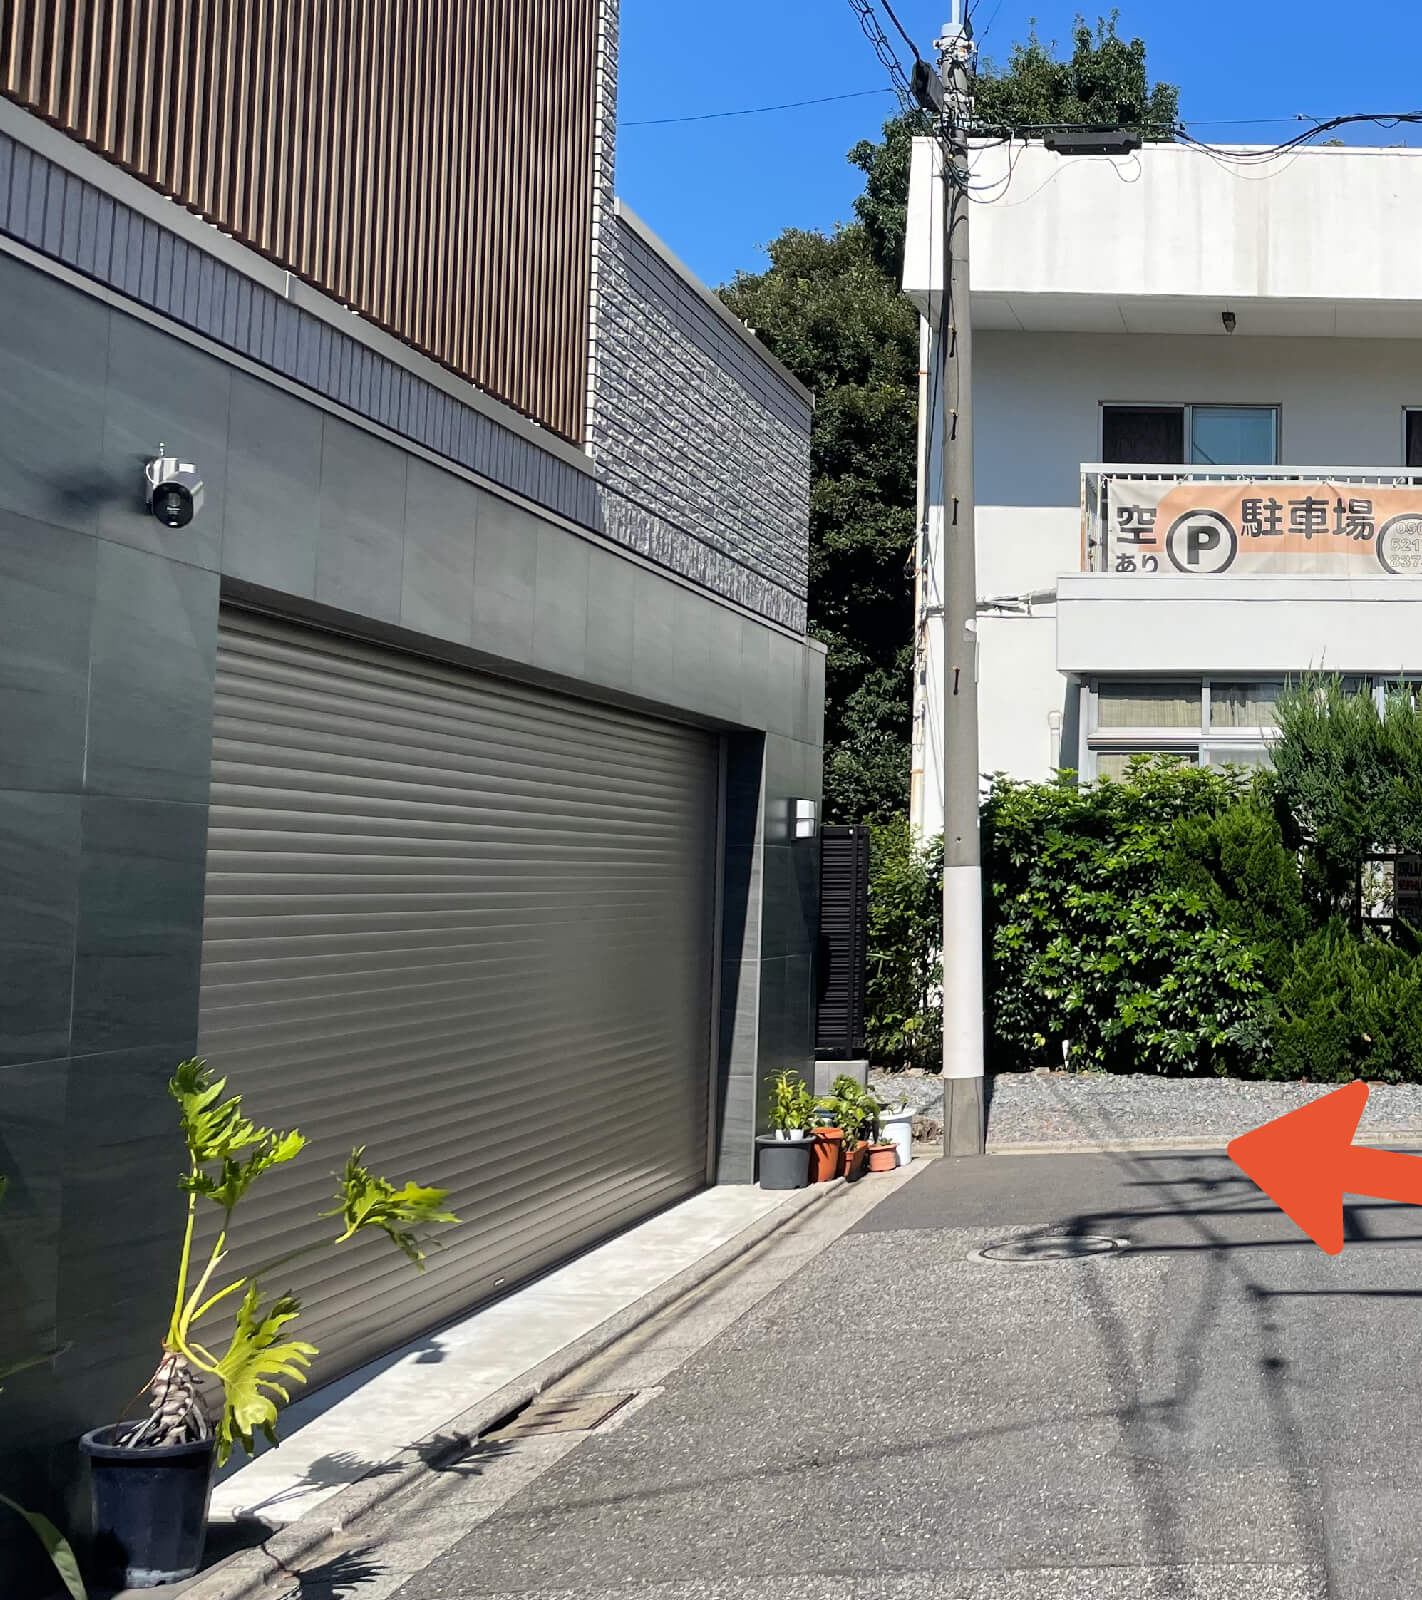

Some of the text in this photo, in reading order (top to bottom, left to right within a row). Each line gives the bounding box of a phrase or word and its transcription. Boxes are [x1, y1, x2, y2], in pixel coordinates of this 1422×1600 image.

[1116, 504, 1157, 545] 空
[1240, 495, 1376, 541] 駐車場
[1115, 552, 1159, 573] あり
[1187, 525, 1221, 565] P
